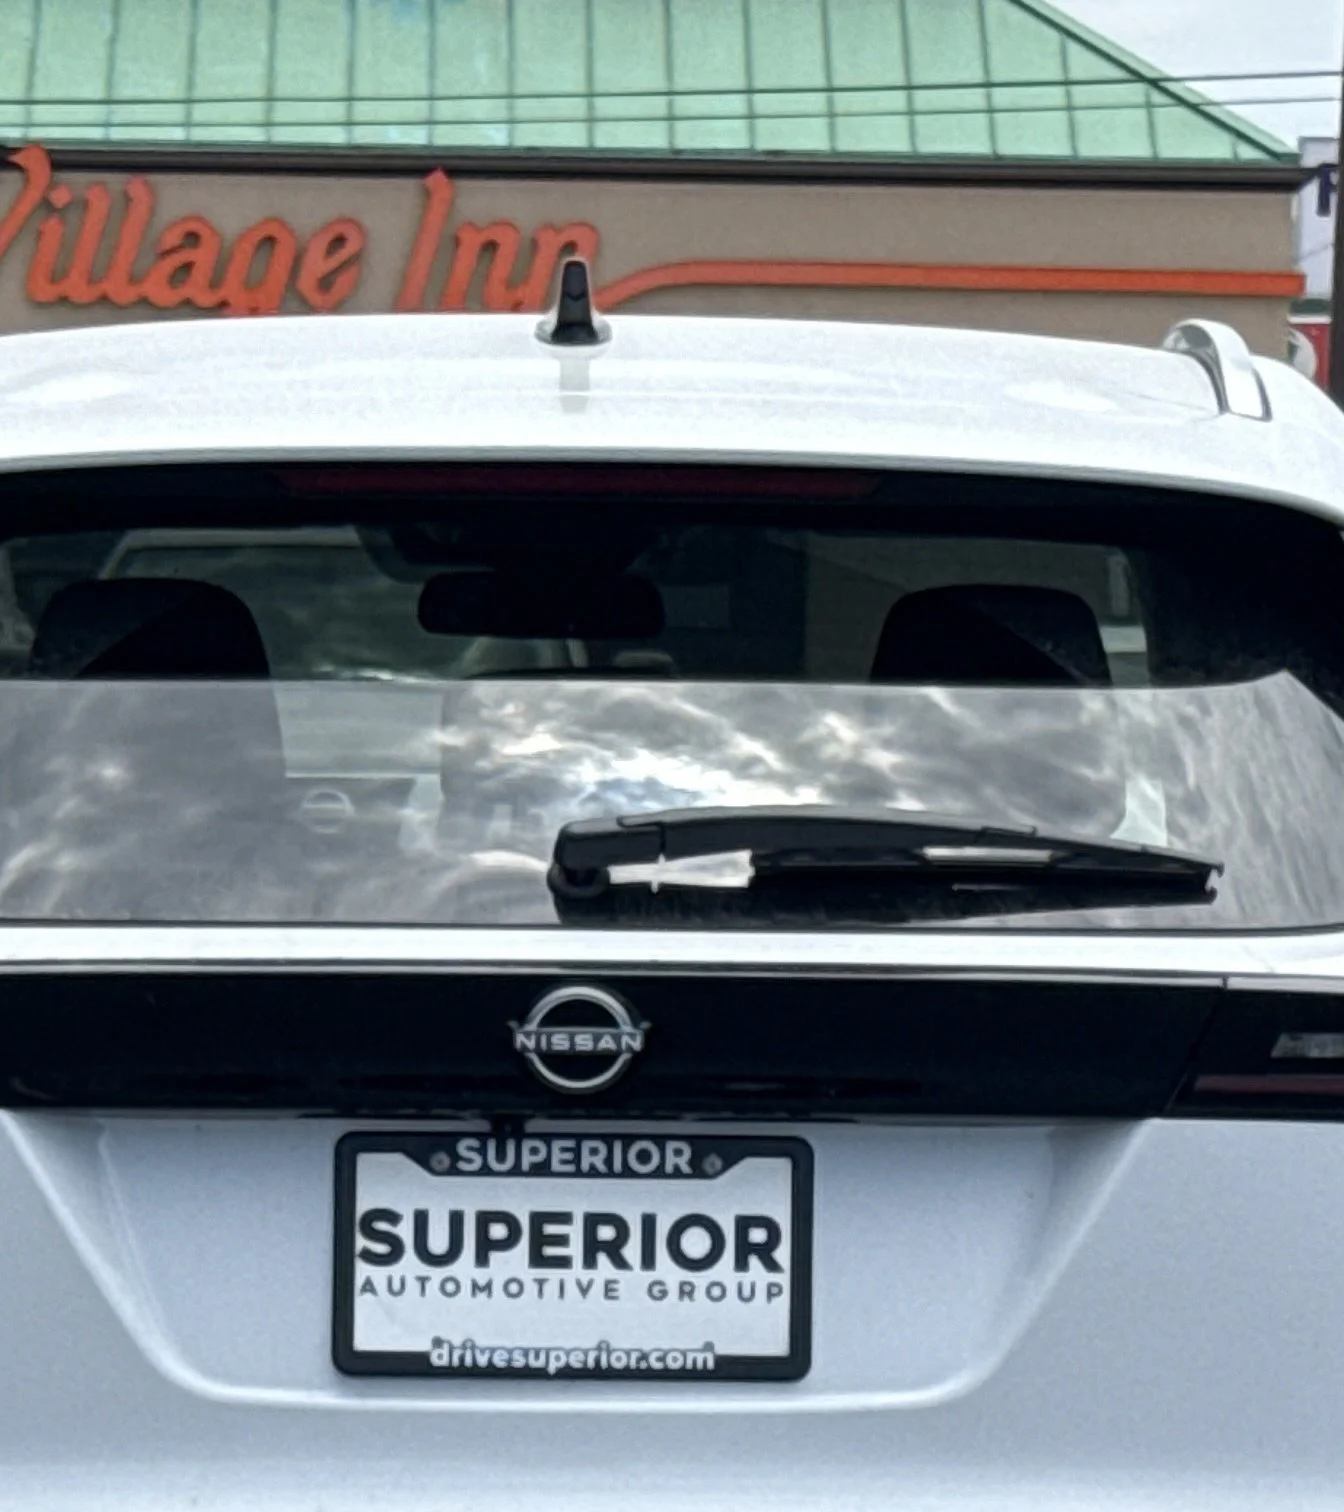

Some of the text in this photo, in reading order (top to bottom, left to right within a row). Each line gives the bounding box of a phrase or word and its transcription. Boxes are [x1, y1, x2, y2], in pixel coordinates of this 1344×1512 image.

[394, 166, 600, 312] Inn
[515, 1032, 641, 1051] NISSAN
[455, 1137, 694, 1176] SUPERIOR
[356, 1208, 784, 1273] SUPERIOR
[359, 1275, 784, 1304] AUTOMOTIVE GROUP
[429, 1340, 716, 1375] drivesuperior.com
